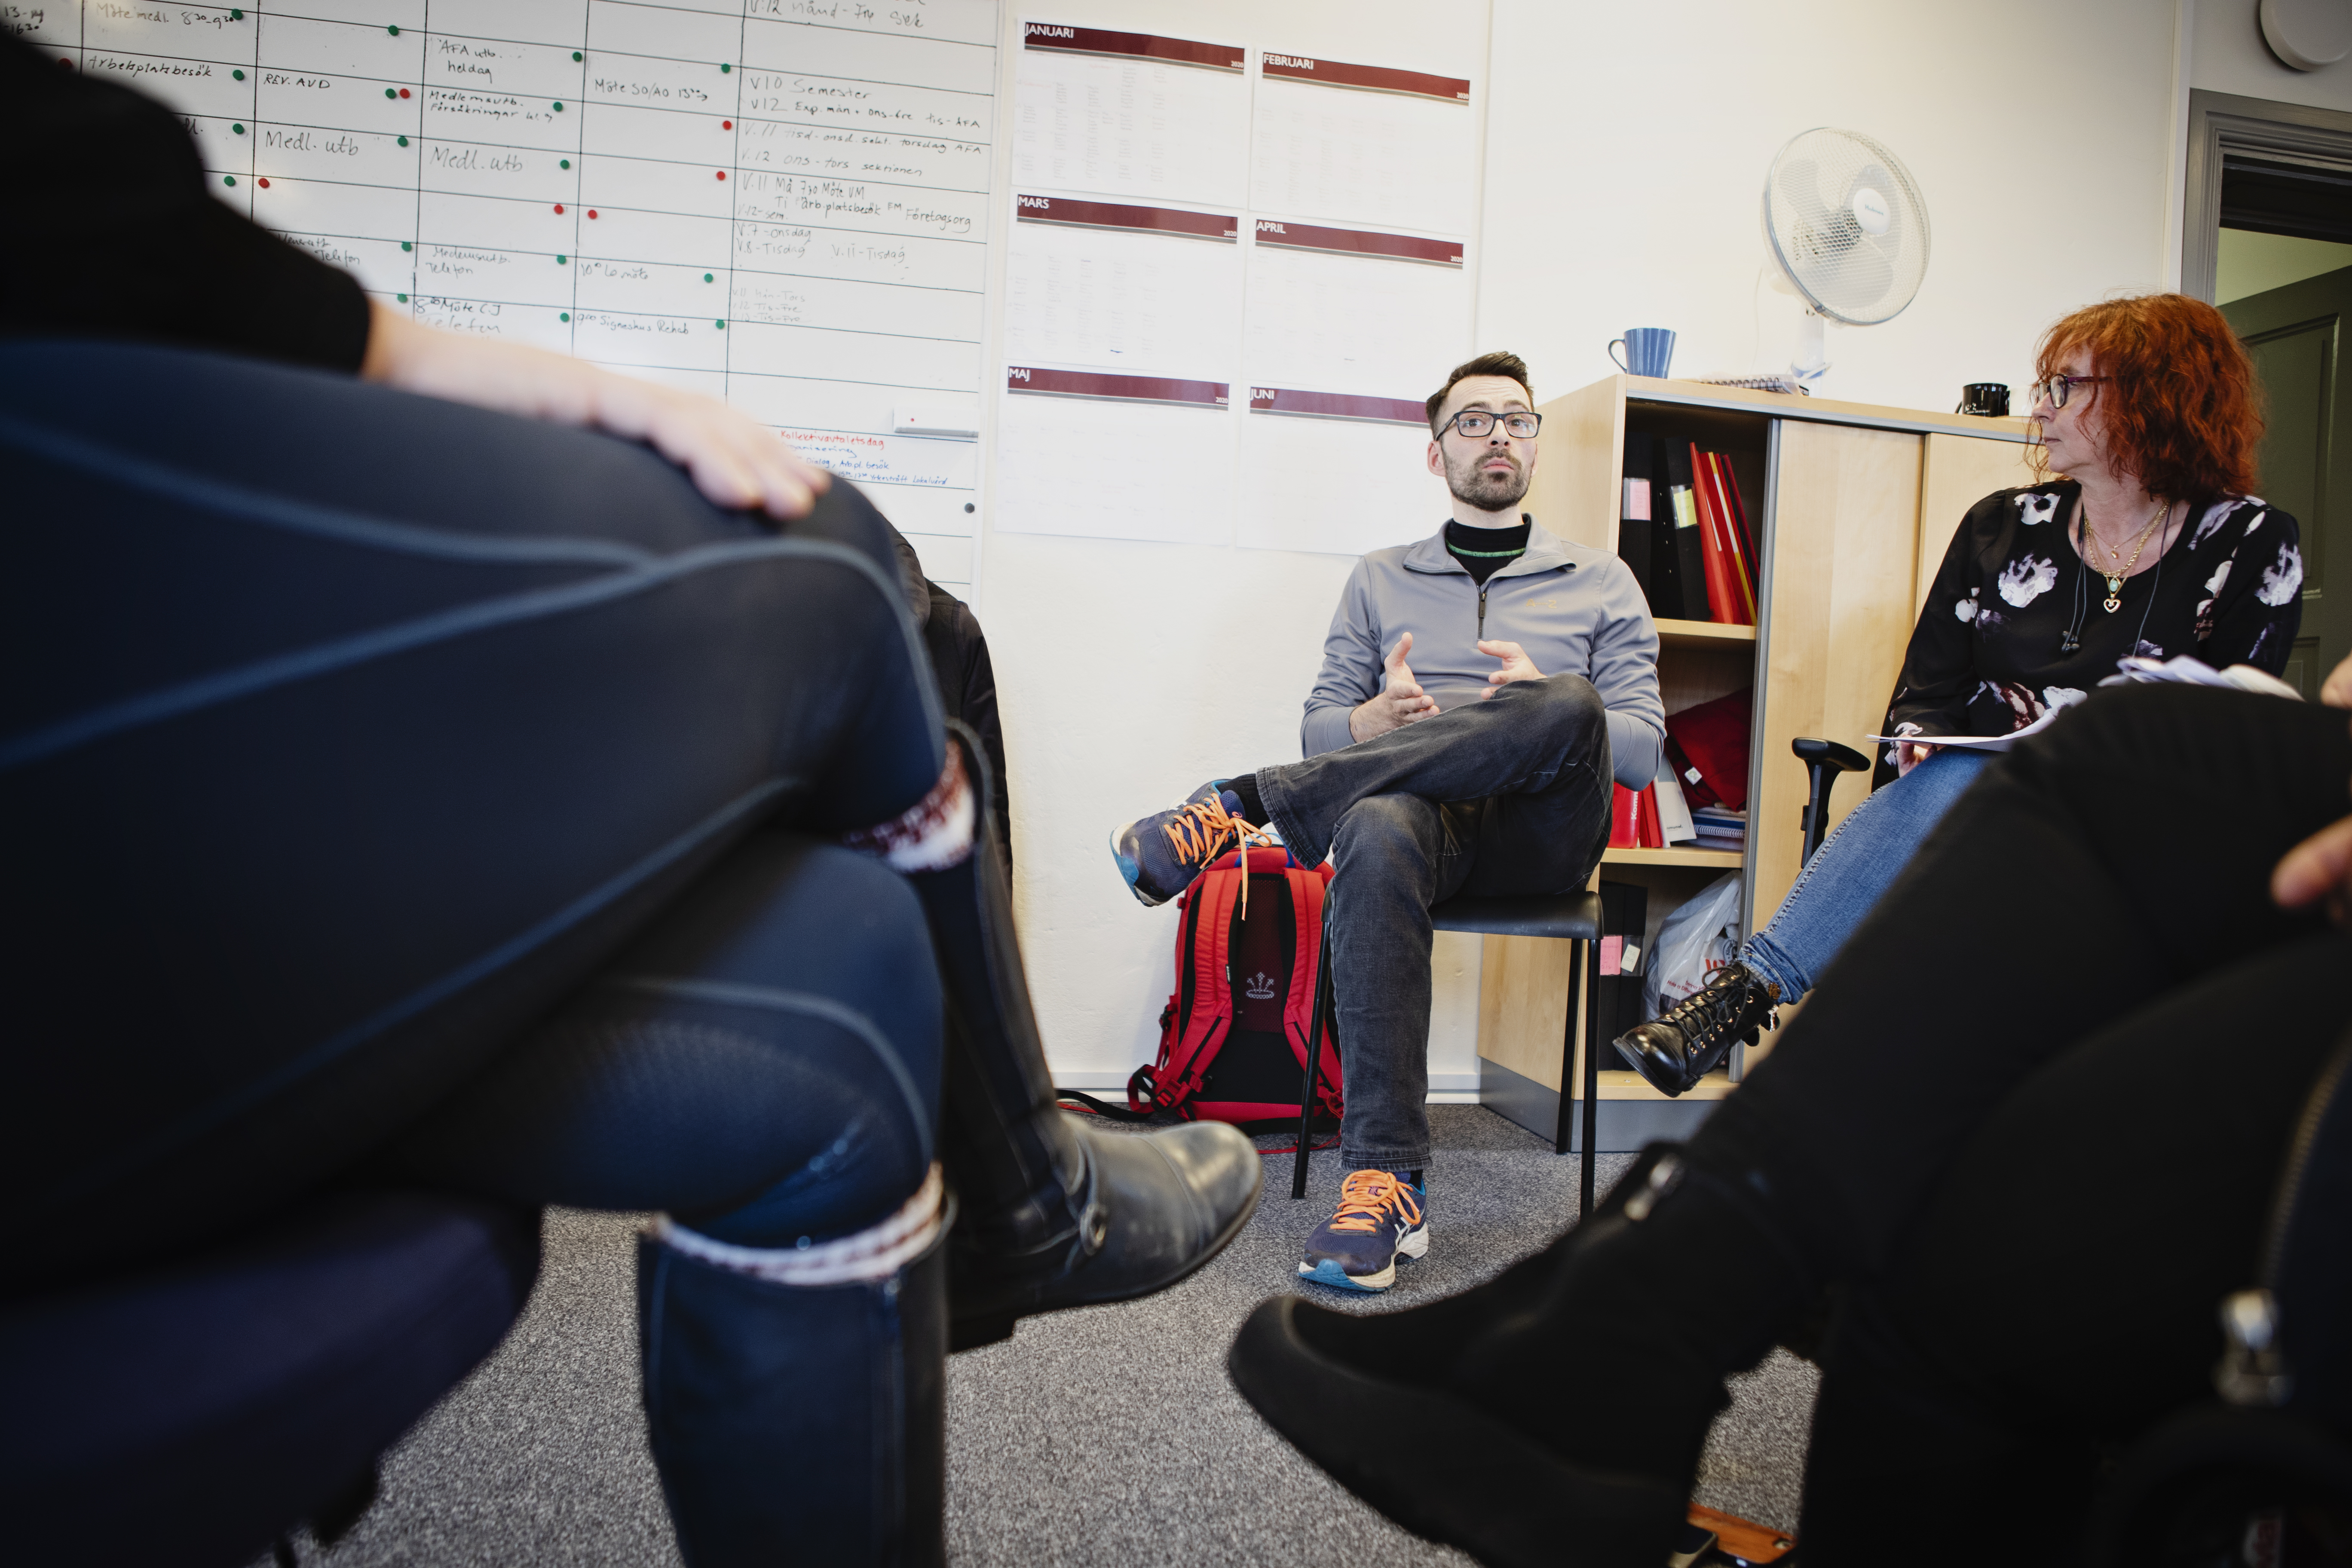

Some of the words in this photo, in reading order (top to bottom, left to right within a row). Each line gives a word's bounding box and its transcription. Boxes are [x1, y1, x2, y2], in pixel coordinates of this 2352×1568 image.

[1025, 24, 1075, 39] JANUARI
[438, 39, 469, 55] AFA
[1231, 60, 1244, 69] 2020
[1263, 53, 1314, 70] FEBRUARI
[448, 60, 492, 84] heldag
[263, 74, 291, 85] REV.
[296, 78, 330, 89] AVD
[595, 79, 626, 93] Möte
[789, 79, 872, 99] Semester
[1457, 92, 1470, 100] 2020
[265, 131, 316, 151] Medl.
[326, 136, 358, 156] utb
[900, 138, 946, 153] torsdag
[954, 145, 981, 154] AFA
[861, 163, 923, 177] sektionen
[1018, 196, 1050, 209] MARS
[905, 208, 971, 233] Företagsorg
[1256, 221, 1286, 234] APRIL
[426, 262, 473, 279] Telefon
[657, 320, 689, 334] Rehab
[1008, 368, 1031, 382] MAJ
[1250, 388, 1274, 401] JUNI
